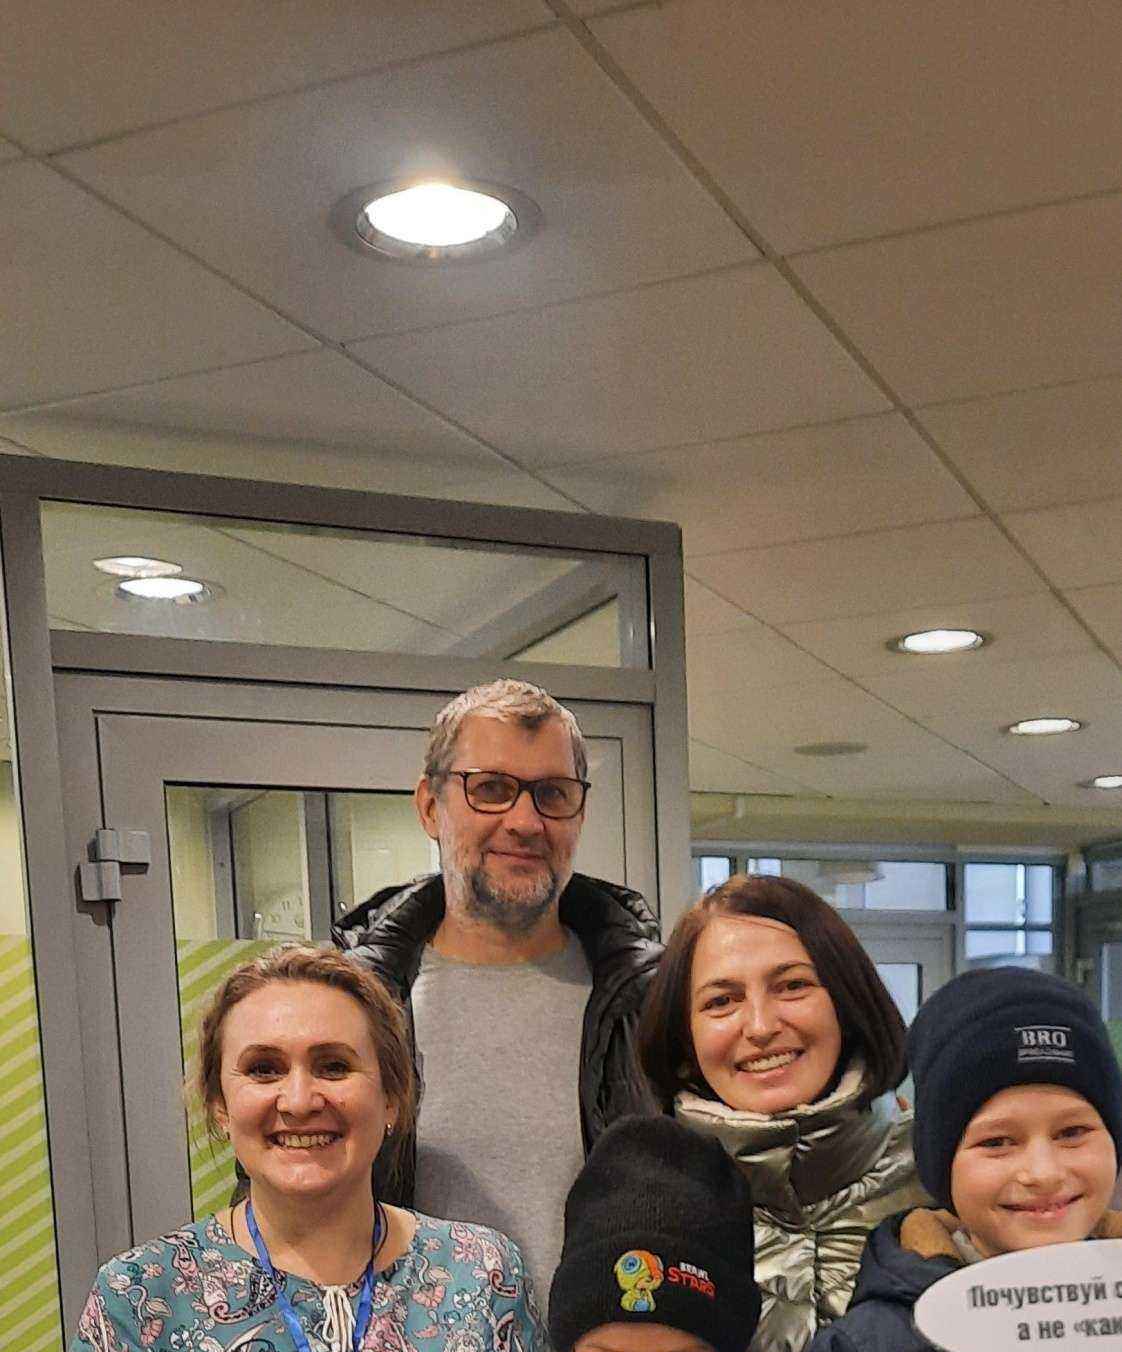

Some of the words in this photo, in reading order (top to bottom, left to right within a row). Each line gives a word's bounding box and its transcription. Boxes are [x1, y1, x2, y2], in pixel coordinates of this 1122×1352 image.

[1022, 1030, 1067, 1047] BRO
[970, 1274, 1107, 1311] Почувствуй
[1017, 1321, 1032, 1340] а
[1039, 1320, 1066, 1340] не
